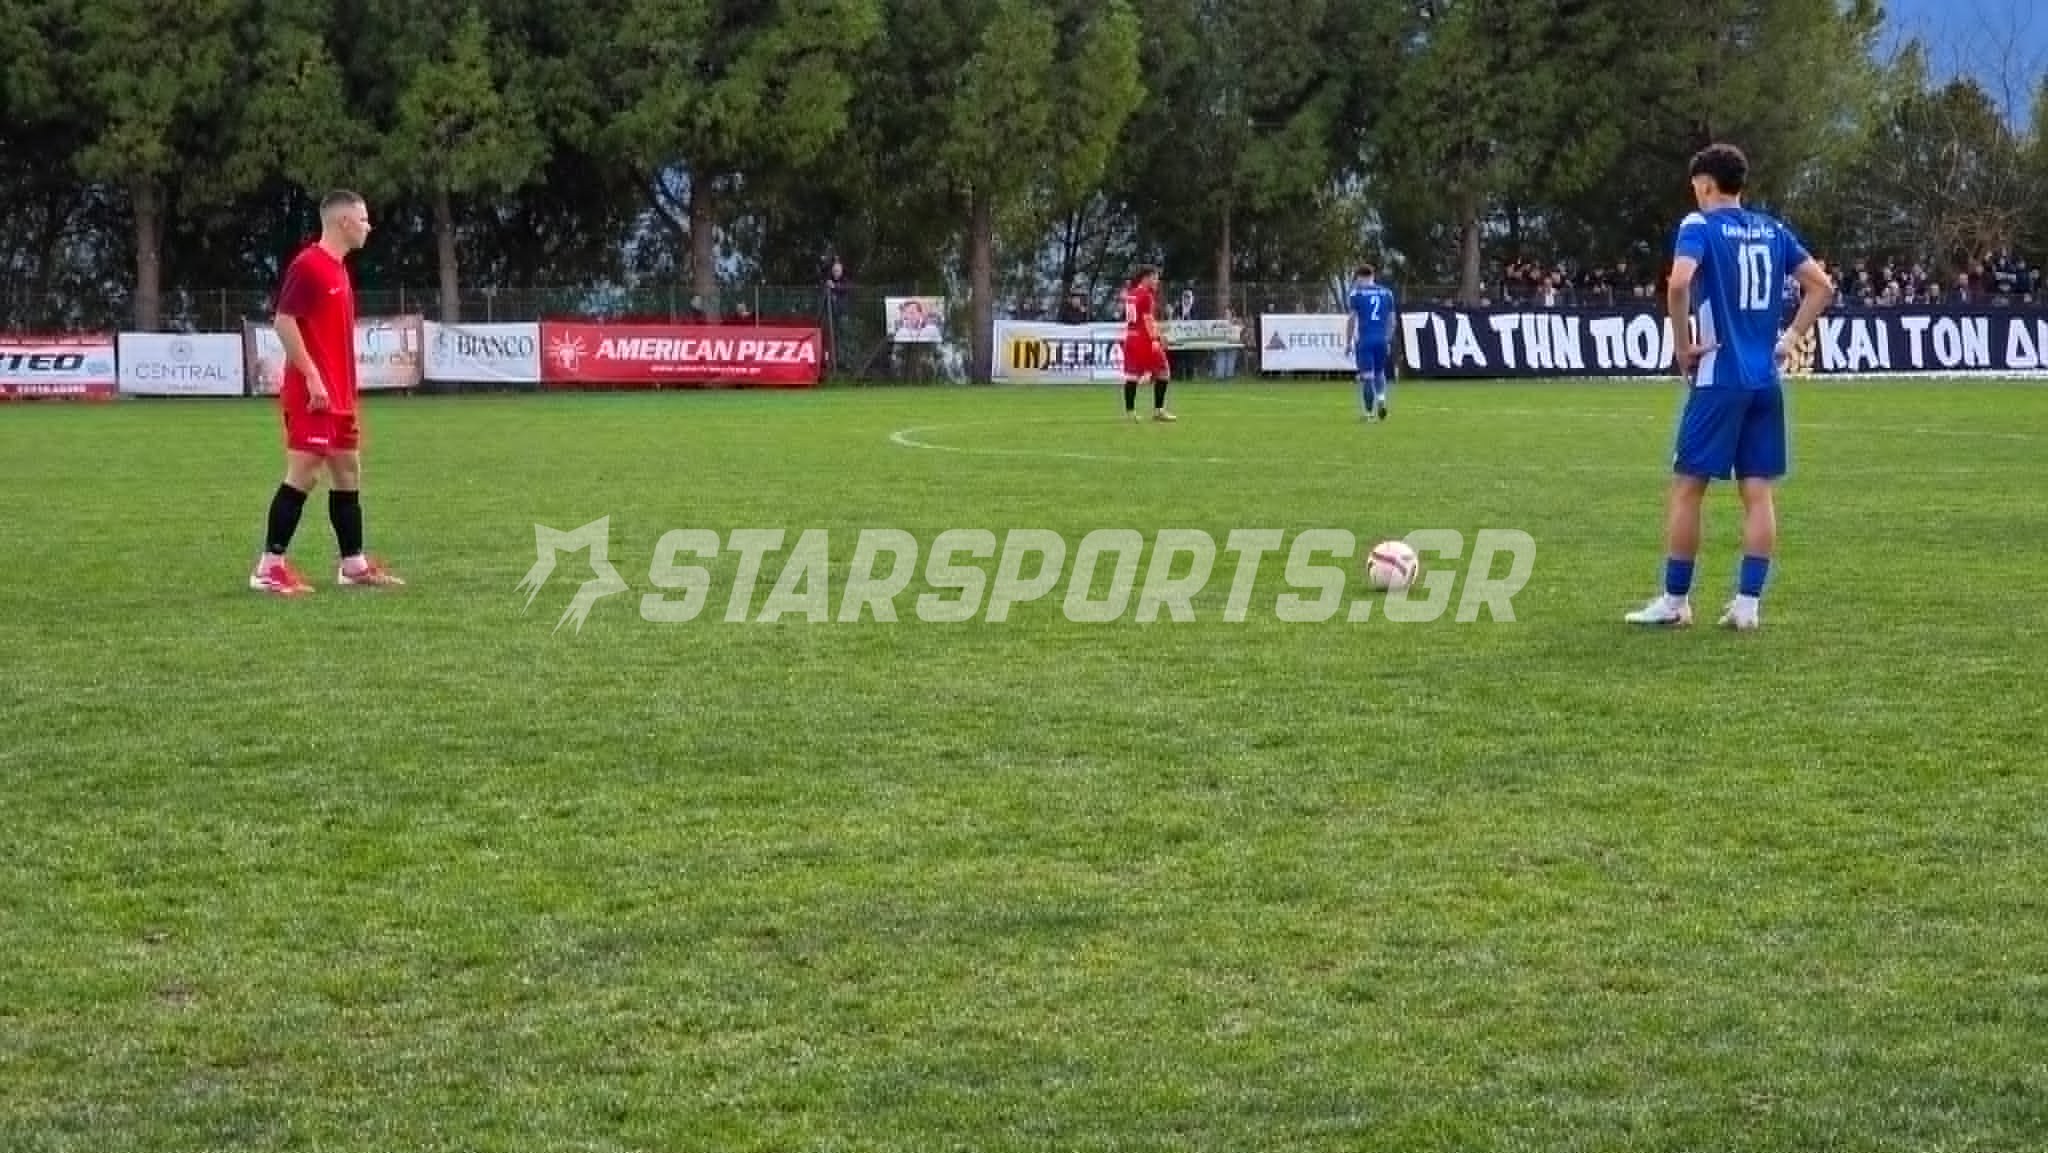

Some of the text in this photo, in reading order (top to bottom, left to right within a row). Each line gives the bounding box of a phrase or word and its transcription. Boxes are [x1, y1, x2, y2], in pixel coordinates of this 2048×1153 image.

[1738, 244, 1771, 310] 10
[1369, 295, 1381, 321] 2
[455, 334, 534, 358] BIANCO
[594, 336, 816, 364] AMERICAN PIZZA
[1400, 312, 1488, 369] ΓΙΑ
[1489, 313, 1585, 370] ΤΗΝ
[1817, 316, 1891, 370] ΚΑΙ
[1901, 316, 1991, 369] ΤΟΝ
[135, 361, 228, 380] CENTRAL
